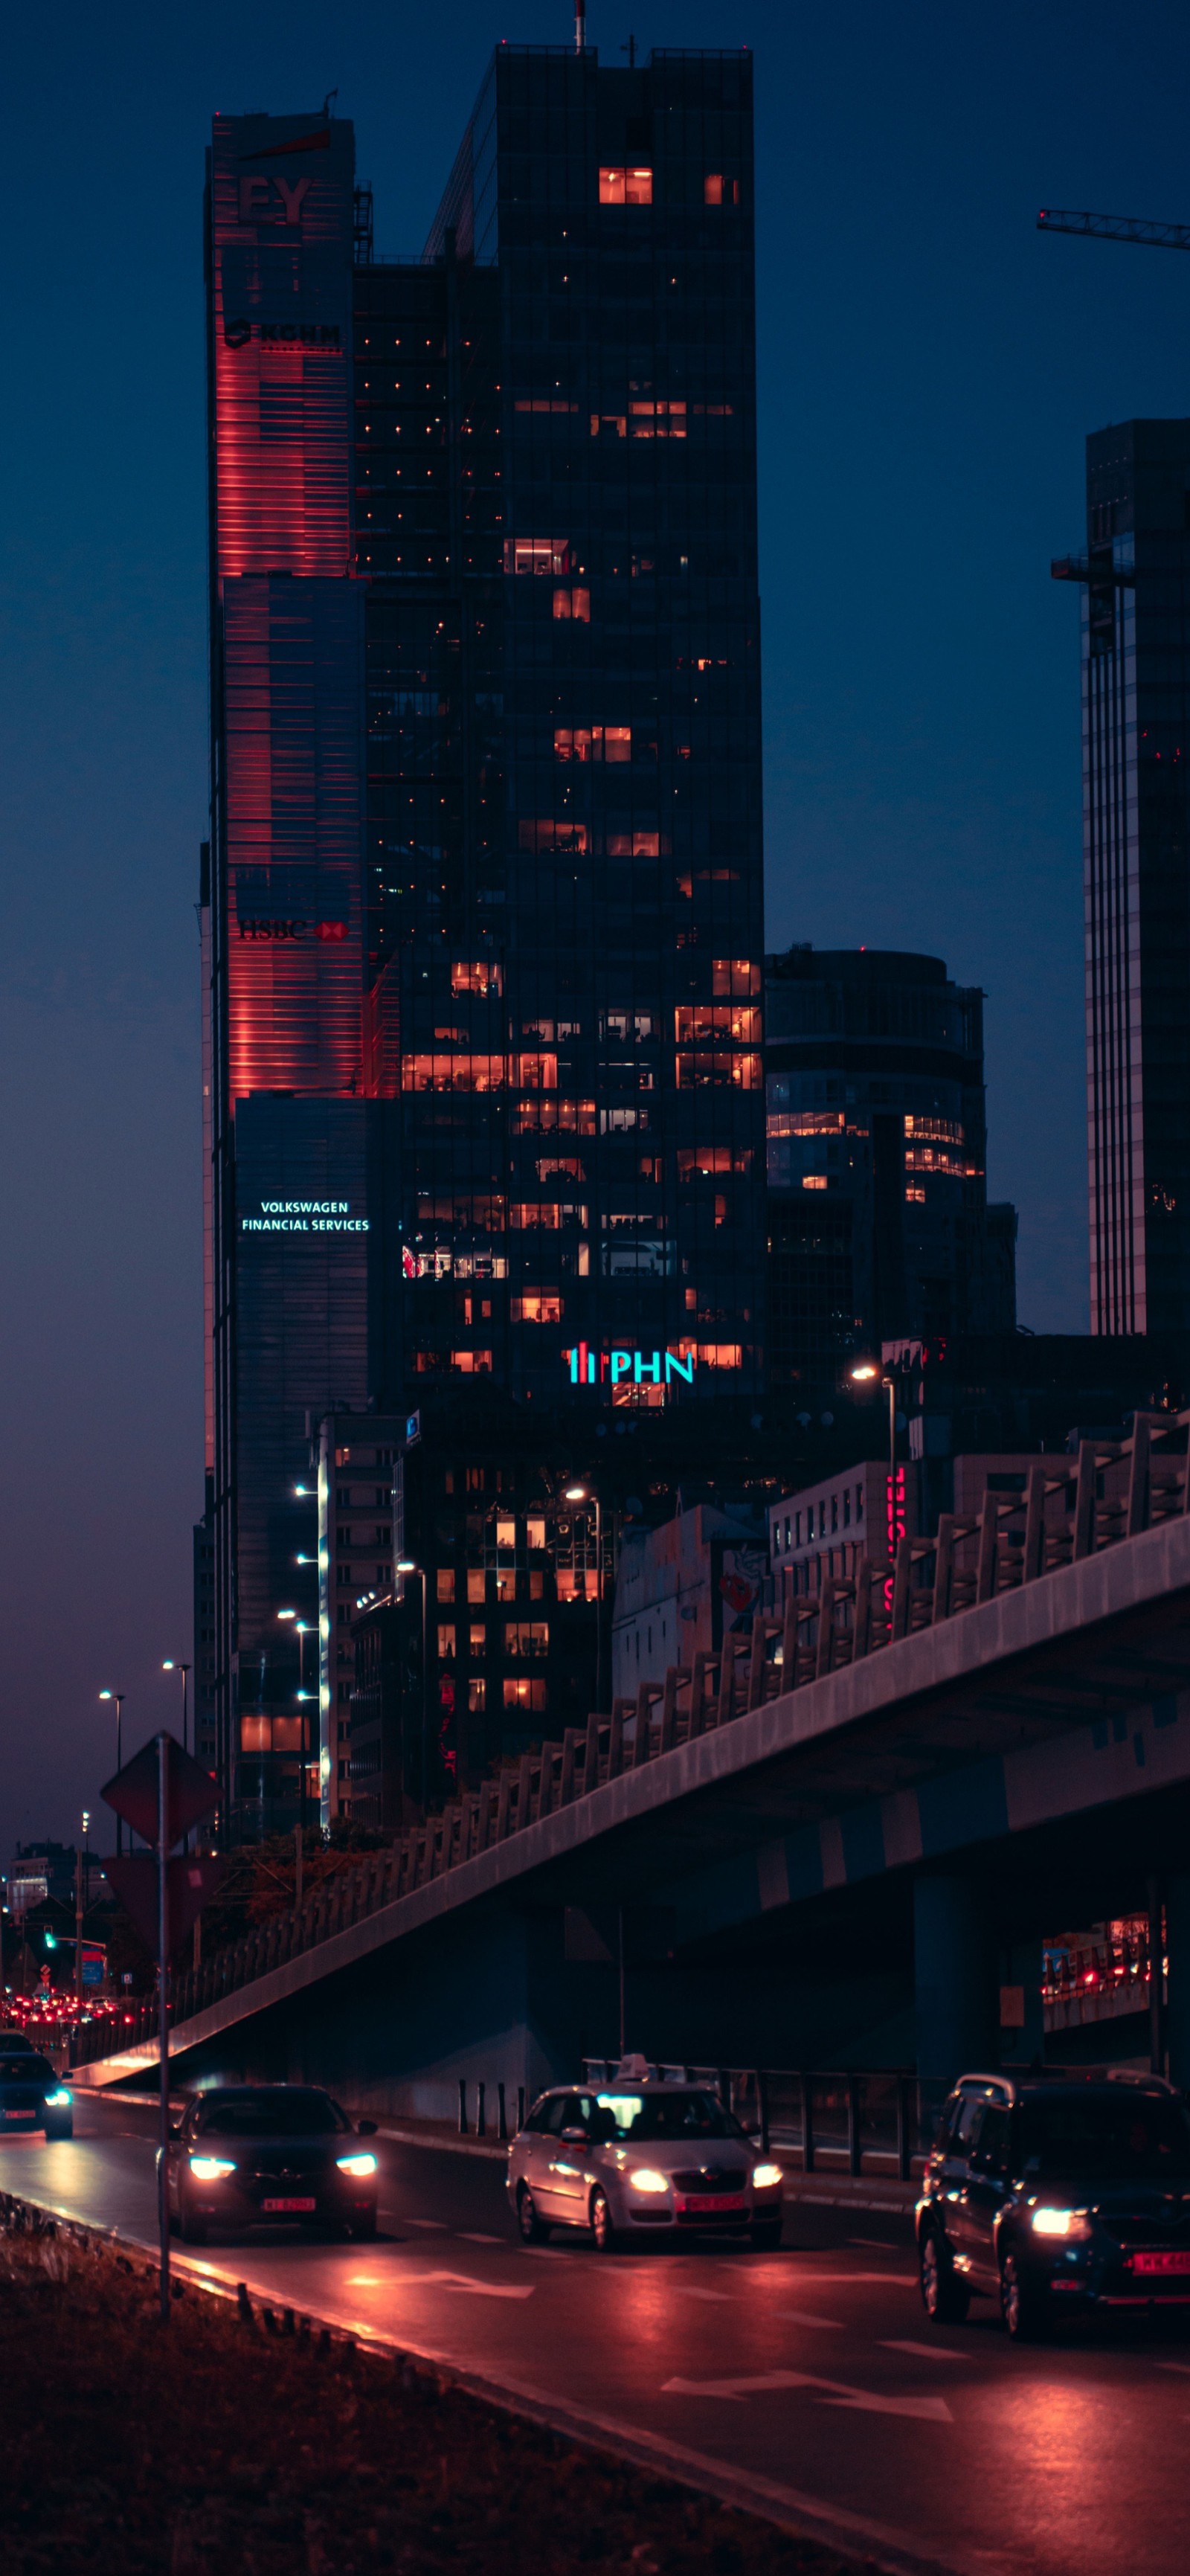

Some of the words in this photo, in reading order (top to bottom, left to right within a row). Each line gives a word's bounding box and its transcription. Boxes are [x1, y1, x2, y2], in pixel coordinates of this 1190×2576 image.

[239, 178, 312, 224] EY
[261, 324, 340, 344] KGHM
[240, 920, 306, 940] HSBC
[261, 1202, 348, 1213] VOLKSWAGEN
[242, 1220, 308, 1231] FINANCIAL
[311, 1220, 369, 1232] SERVICES
[611, 1352, 692, 1383] PHN
[887, 1467, 905, 1561] OTEL
